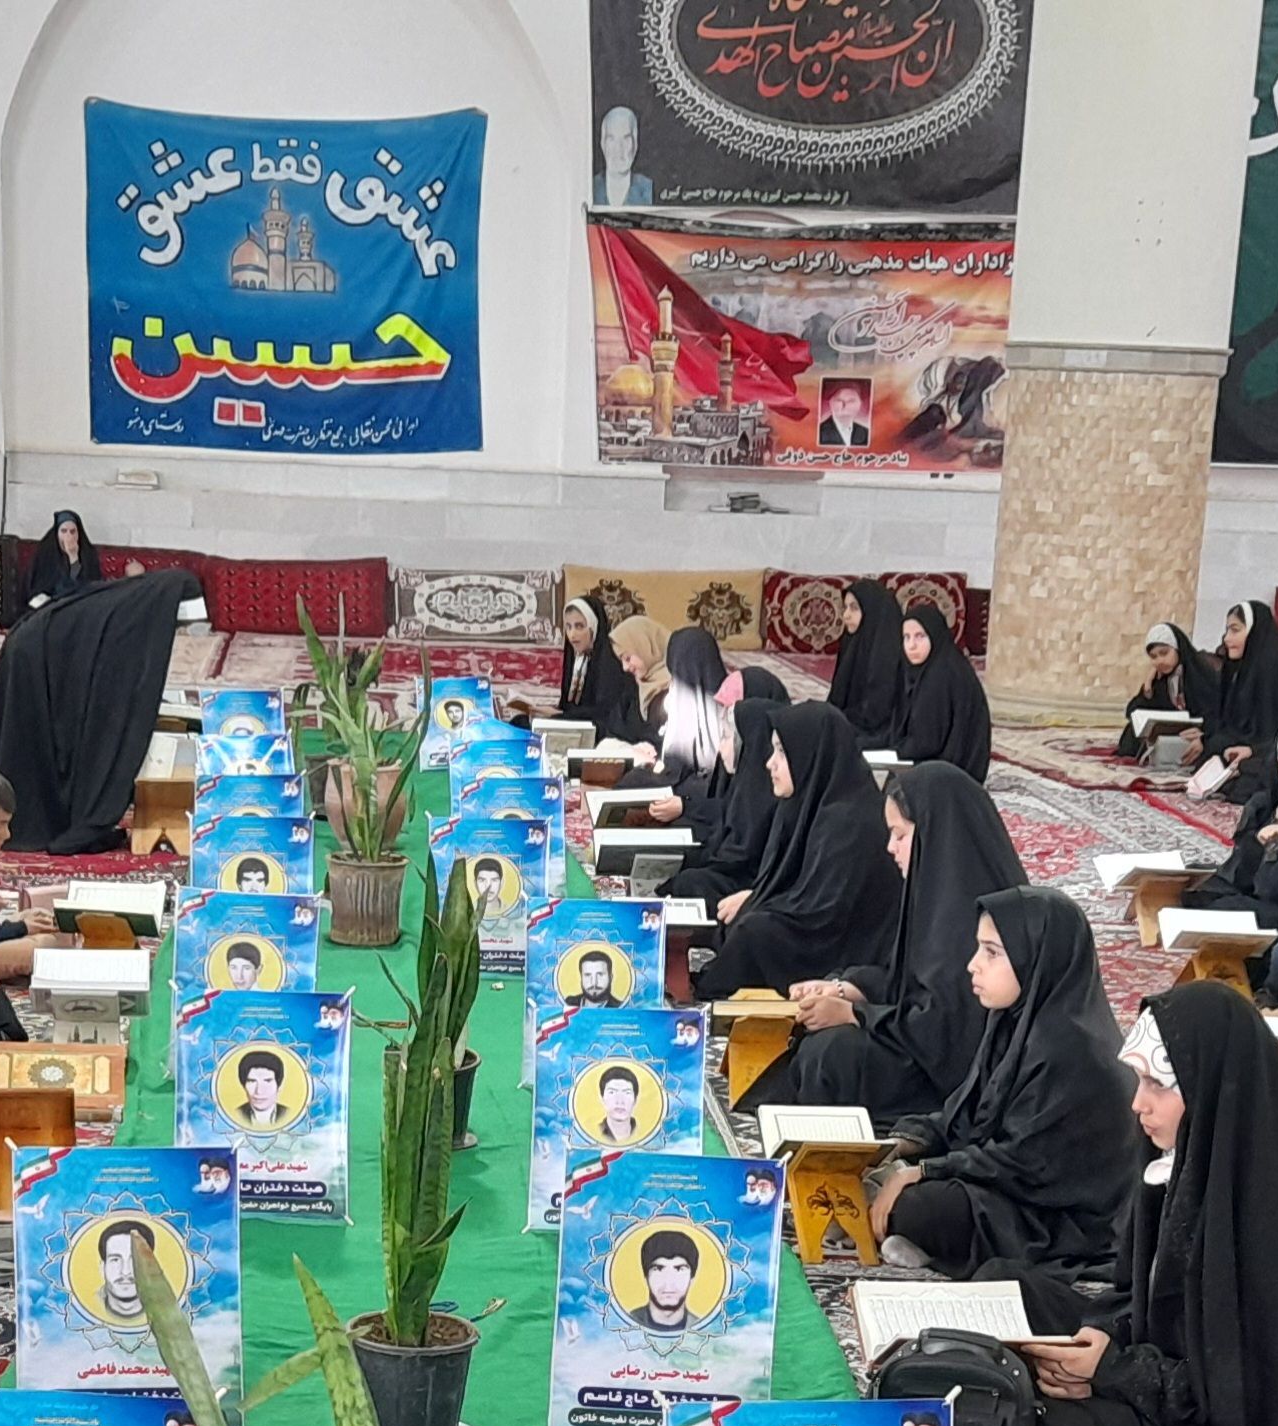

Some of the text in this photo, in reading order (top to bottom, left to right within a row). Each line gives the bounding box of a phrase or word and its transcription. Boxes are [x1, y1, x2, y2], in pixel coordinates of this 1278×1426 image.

[701, 187, 717, 201] حاج
[716, 188, 742, 203] مرحوم
[116, 138, 457, 277] عشق فقط عشق
[690, 246, 1015, 277] زاداران هیأت مذهبی را گرامی می داریم
[110, 312, 452, 427] حسین
[832, 449, 853, 467] حاج
[855, 451, 890, 468] مرحوم
[286, 1160, 309, 1174] شهید
[239, 1181, 253, 1192] حا
[253, 1181, 291, 1195] دختران
[239, 1200, 333, 1213] پایگاه بسیج خواهران حضر
[77, 1361, 172, 1380] هید محمد فاطمی
[610, 1364, 710, 1385] شهید حسین رضایی
[583, 1390, 623, 1404] قاسم
[625, 1392, 650, 1408] حاج
[570, 1412, 598, 1424] خاتون
[599, 1414, 628, 1426] نفیسه
